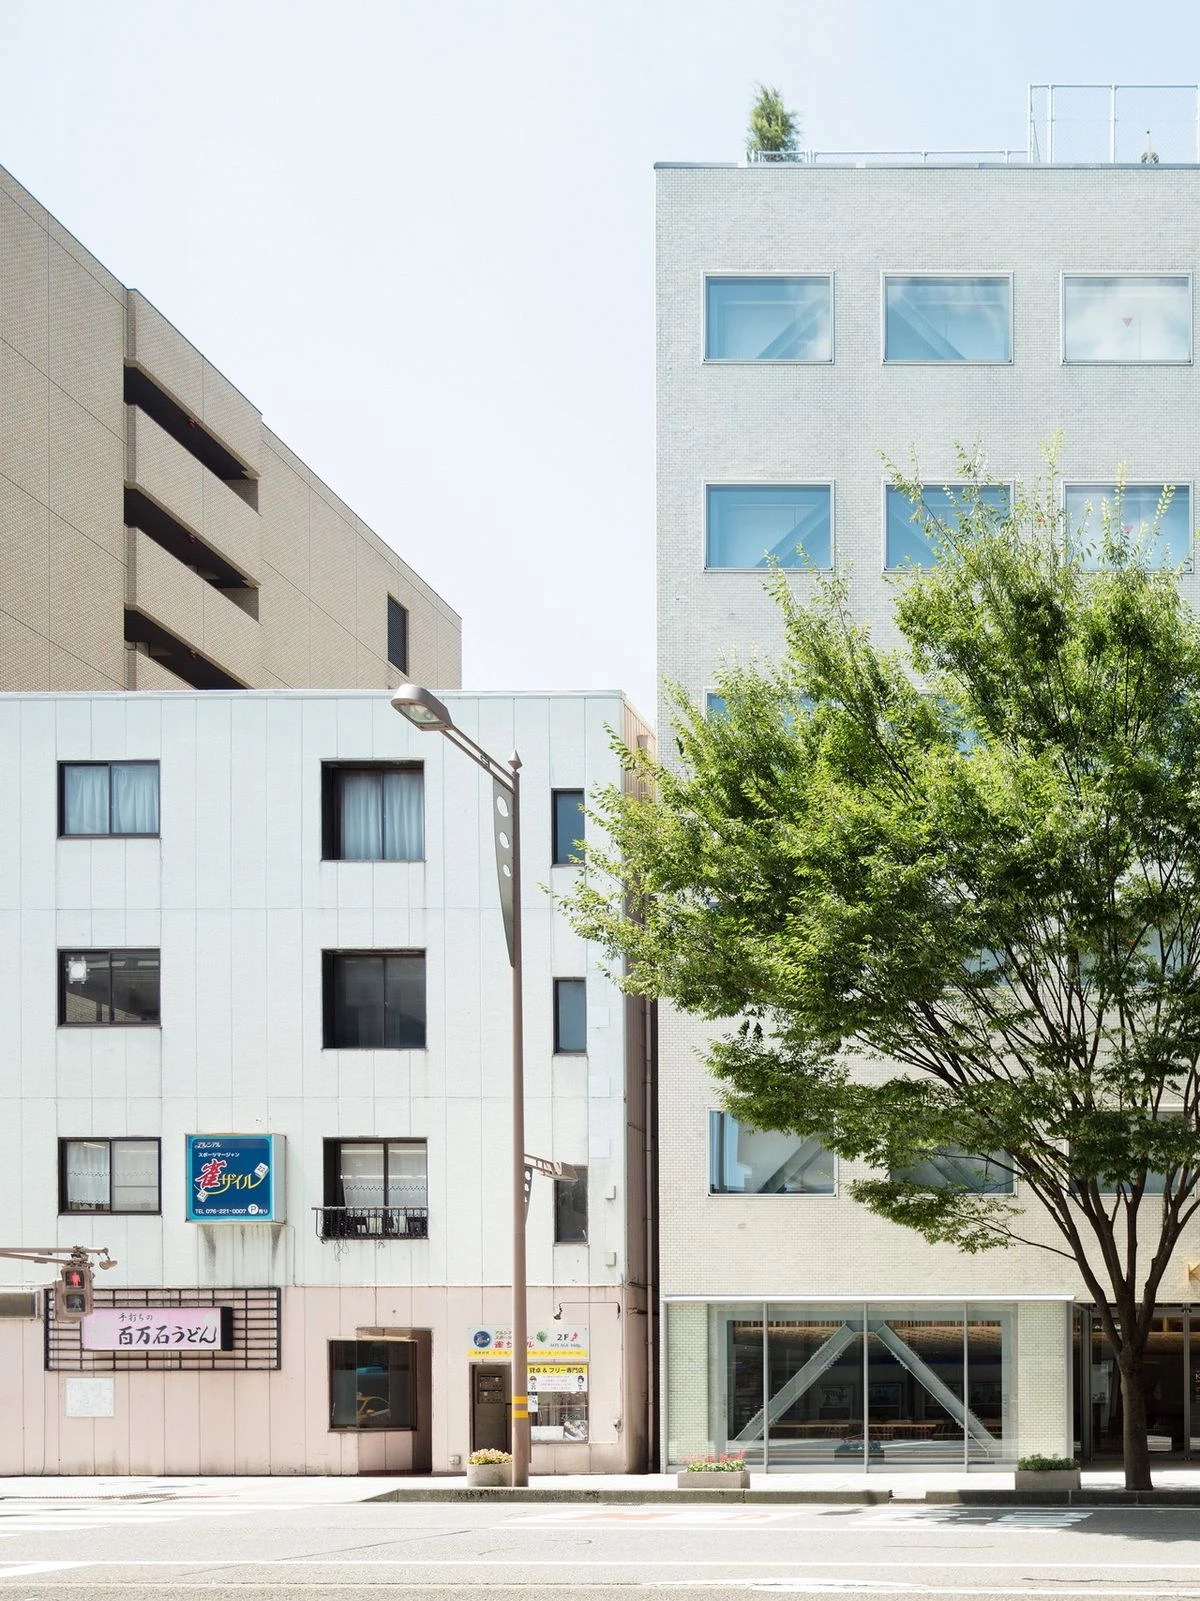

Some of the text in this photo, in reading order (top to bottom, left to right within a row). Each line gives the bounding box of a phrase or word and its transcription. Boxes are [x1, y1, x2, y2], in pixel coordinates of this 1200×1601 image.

[118, 1312, 153, 1322] 手打ちの
[118, 1325, 217, 1345] 百万石うどん
[557, 1333, 569, 1341] 2F
